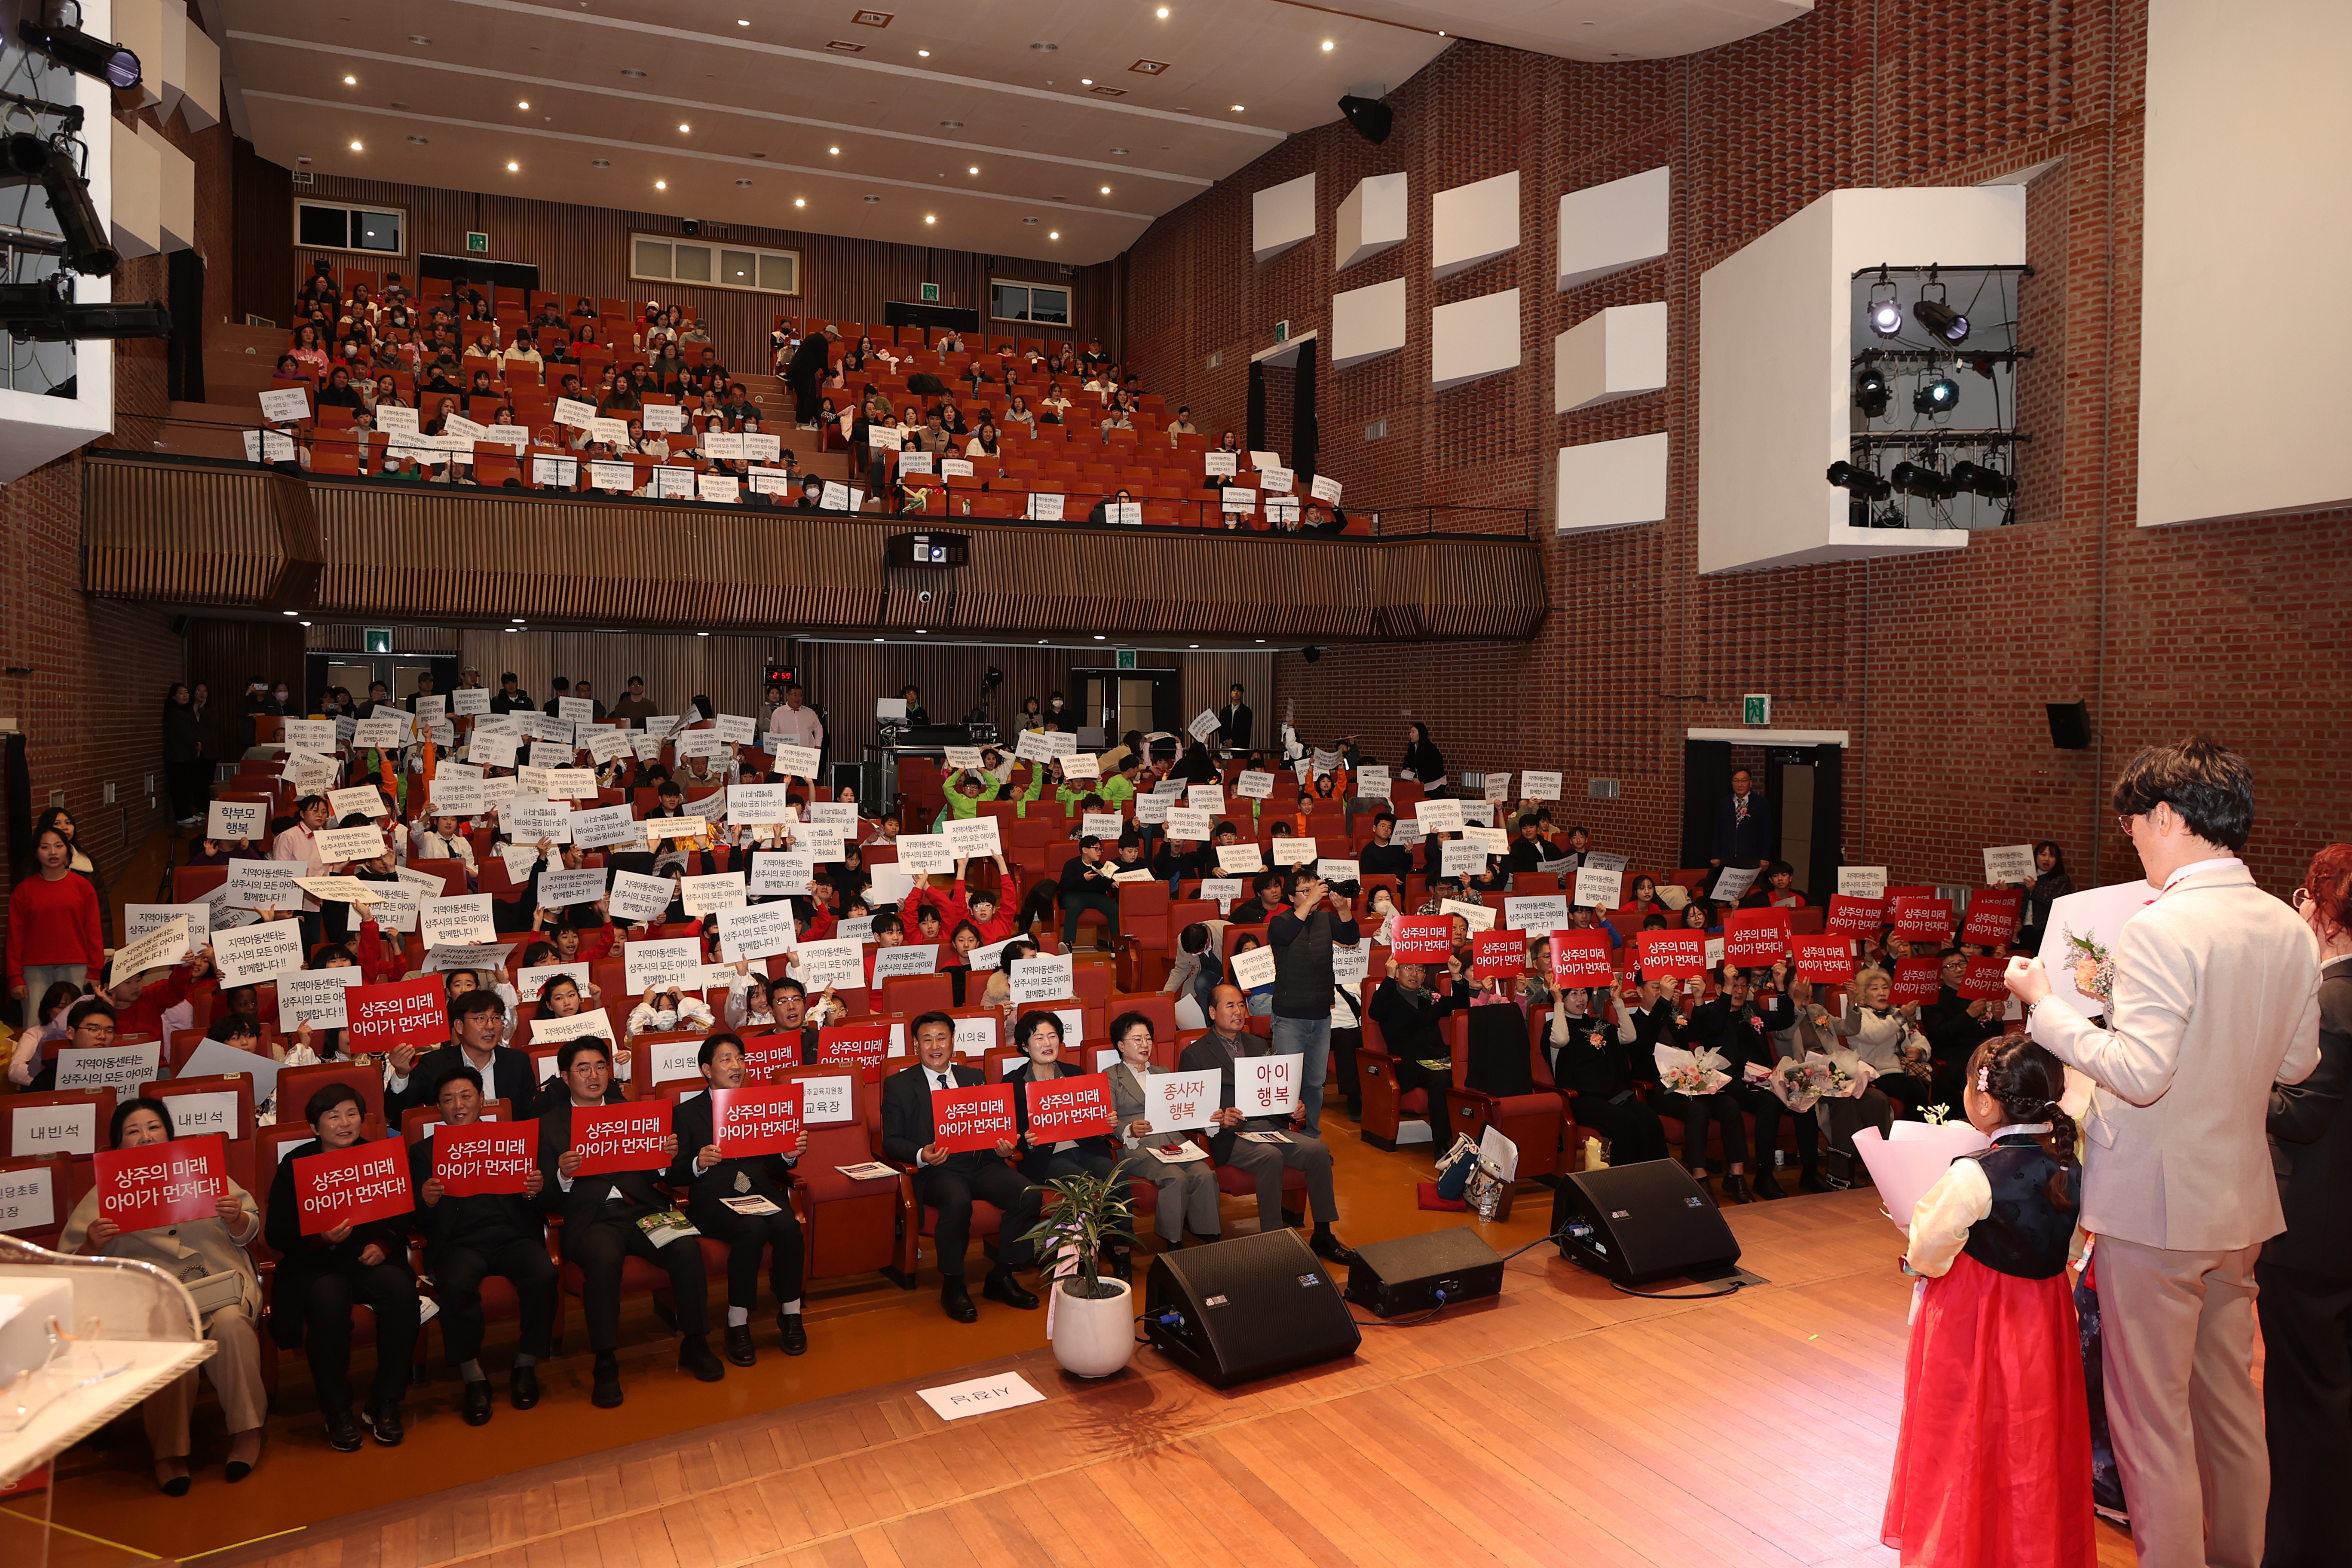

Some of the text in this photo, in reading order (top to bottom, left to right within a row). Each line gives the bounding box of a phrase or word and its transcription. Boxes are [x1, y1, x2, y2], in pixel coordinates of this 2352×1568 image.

[744, 790, 773, 798] 함께합니다
[730, 800, 747, 808] 아이와
[760, 799, 783, 807] 상주시의
[221, 807, 255, 819] 학부모
[737, 809, 776, 818] 지역아동센터는
[1173, 812, 1203, 820] 지역아동센터는
[226, 822, 249, 834] 행복
[325, 832, 370, 842] 지역아동센터는
[320, 841, 347, 851] 상주시의
[334, 847, 366, 857] 함께합니다
[1584, 874, 1615, 884] 지역아동센터는
[1577, 882, 1619, 894] 상주시의 모든 아이와
[1585, 892, 1608, 902] 함께합니다
[432, 902, 480, 915] 지역아동센터는
[424, 913, 490, 929] 상주시의 모든 아이와
[730, 910, 780, 927] 지역아동센터는
[228, 930, 286, 948] 지역아동센터는
[438, 927, 473, 940] 함께합니다
[723, 921, 790, 942] 상주시의 모든 아이와
[1400, 926, 1446, 939] 상주의 미래
[1733, 927, 1778, 942] 상주의 미래
[737, 937, 774, 952] 함께합니다
[1395, 939, 1450, 952] 아이가 먼저다!
[1648, 940, 1698, 954] 상주의 미래
[1727, 940, 1783, 956] 아이가 먼저다!
[219, 941, 298, 965] 상주시의 모든 아이와
[1560, 947, 1606, 962] 상주의 미래
[1643, 954, 1704, 968] 아이가 먼저다!
[237, 959, 279, 976] 함께합니다
[1021, 963, 1064, 975] 지역아동센터는
[1555, 961, 1611, 976] 아이가 먼저다!
[1013, 973, 1071, 988] 상주시의 모든 아이와
[1025, 987, 1057, 999] 함께합니다
[359, 992, 434, 1018] 상주의 미래
[352, 1010, 443, 1036] 아이가 먼저다!
[956, 1032, 986, 1043] 시의원
[744, 1045, 792, 1064] 주의 미래
[829, 1038, 883, 1055] 상주의 미래
[663, 1057, 696, 1069] 시의원
[1257, 1063, 1289, 1083] 아이
[1164, 1080, 1205, 1100] 종사자
[1257, 1086, 1289, 1107] 행복
[1038, 1088, 1099, 1110] 상주의 미래
[726, 1099, 793, 1121] 상주의 미래
[804, 1101, 840, 1114] 교육장
[944, 1098, 1004, 1120] 상주의 미래
[1169, 1101, 1196, 1121] 행복
[179, 1111, 222, 1126] 내빈석
[1032, 1104, 1107, 1128] 아이가 먼저다!
[31, 1124, 79, 1140] 내빈석
[585, 1116, 659, 1139] 상주의 미래
[717, 1118, 799, 1144] 아이가 먼저다!
[938, 1116, 1011, 1137] 아이가 먼저다!
[447, 1138, 525, 1160] 상주의 미래
[576, 1139, 619, 1158] 아이가
[114, 1155, 208, 1188] 상주의 미래
[312, 1157, 395, 1191] 상주의 미래
[437, 1157, 533, 1179] 아이가 먼저다!
[105, 1177, 220, 1212] 아이가 먼저다!
[304, 1176, 406, 1213] 아이가 먼저다!
[950, 1387, 1009, 1405] 시장님
